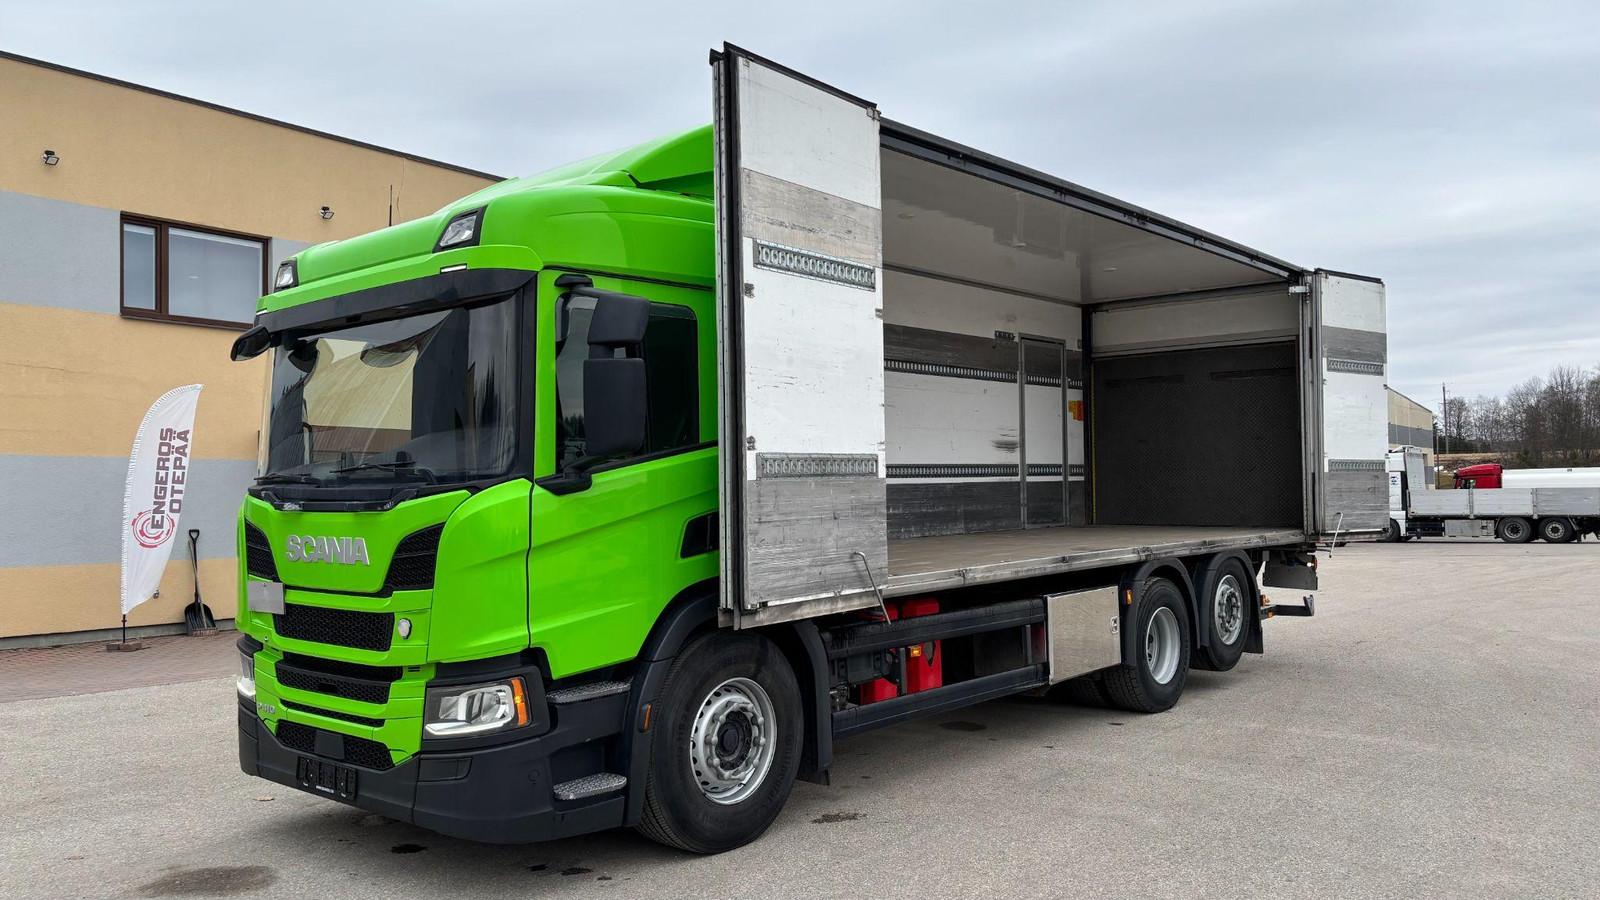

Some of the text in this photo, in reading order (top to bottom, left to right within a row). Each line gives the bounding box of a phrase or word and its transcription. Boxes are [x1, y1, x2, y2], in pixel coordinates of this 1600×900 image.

[151, 427, 173, 529] ENGEROS
[169, 429, 190, 514] OTEPÄÄ
[286, 534, 369, 566] SCANIA
